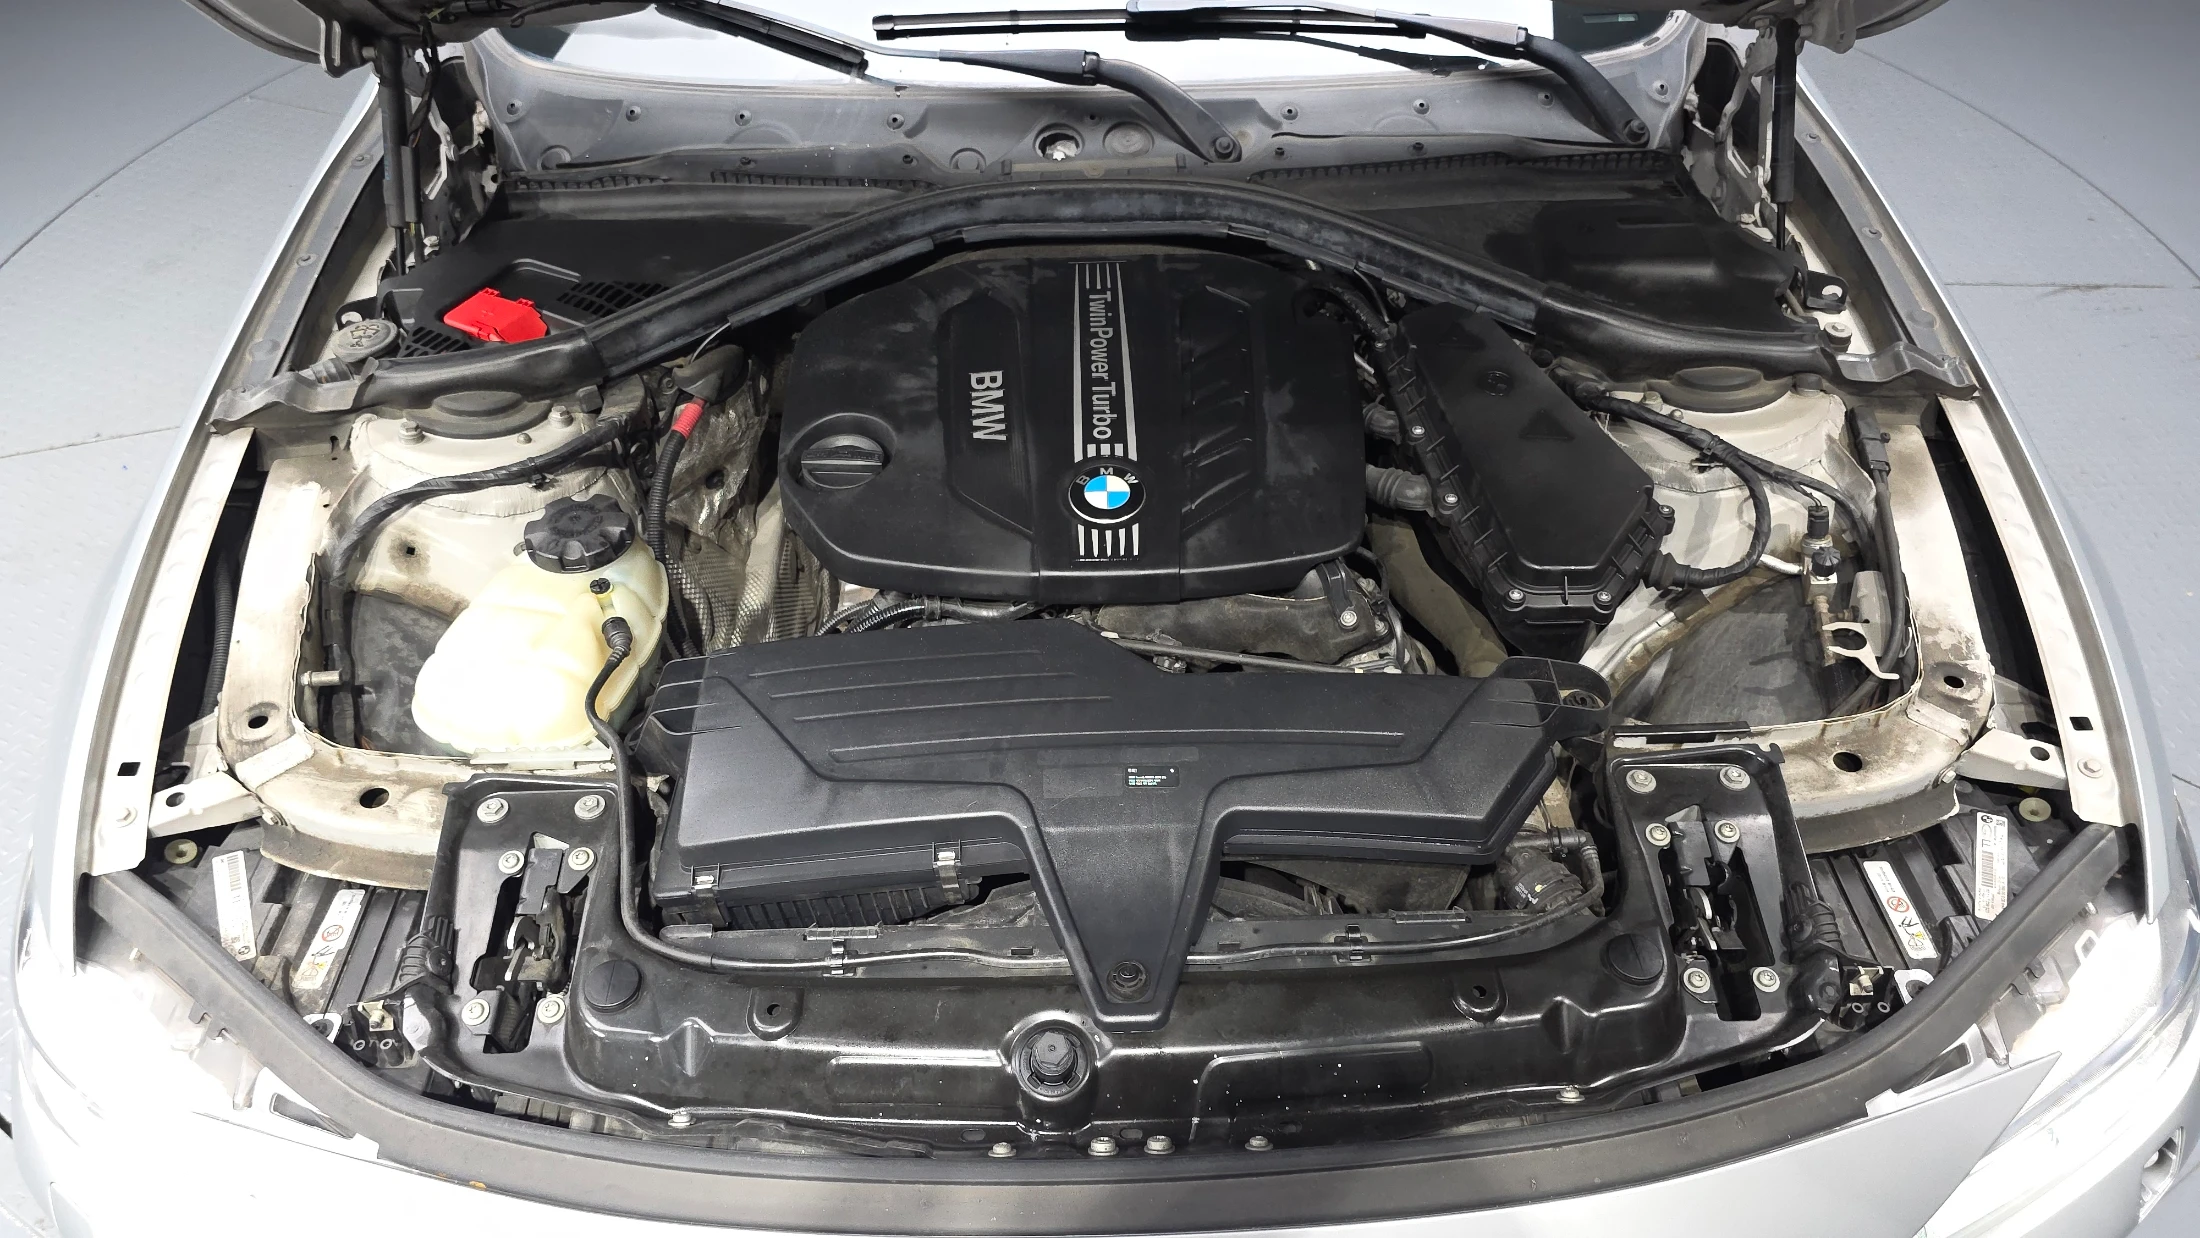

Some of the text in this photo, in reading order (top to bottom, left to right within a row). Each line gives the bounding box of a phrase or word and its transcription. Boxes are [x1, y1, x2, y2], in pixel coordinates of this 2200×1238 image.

[1089, 290, 1118, 440] TwinPower Turbo
[969, 370, 1008, 441] BMW
[1076, 466, 1139, 486] BMW
